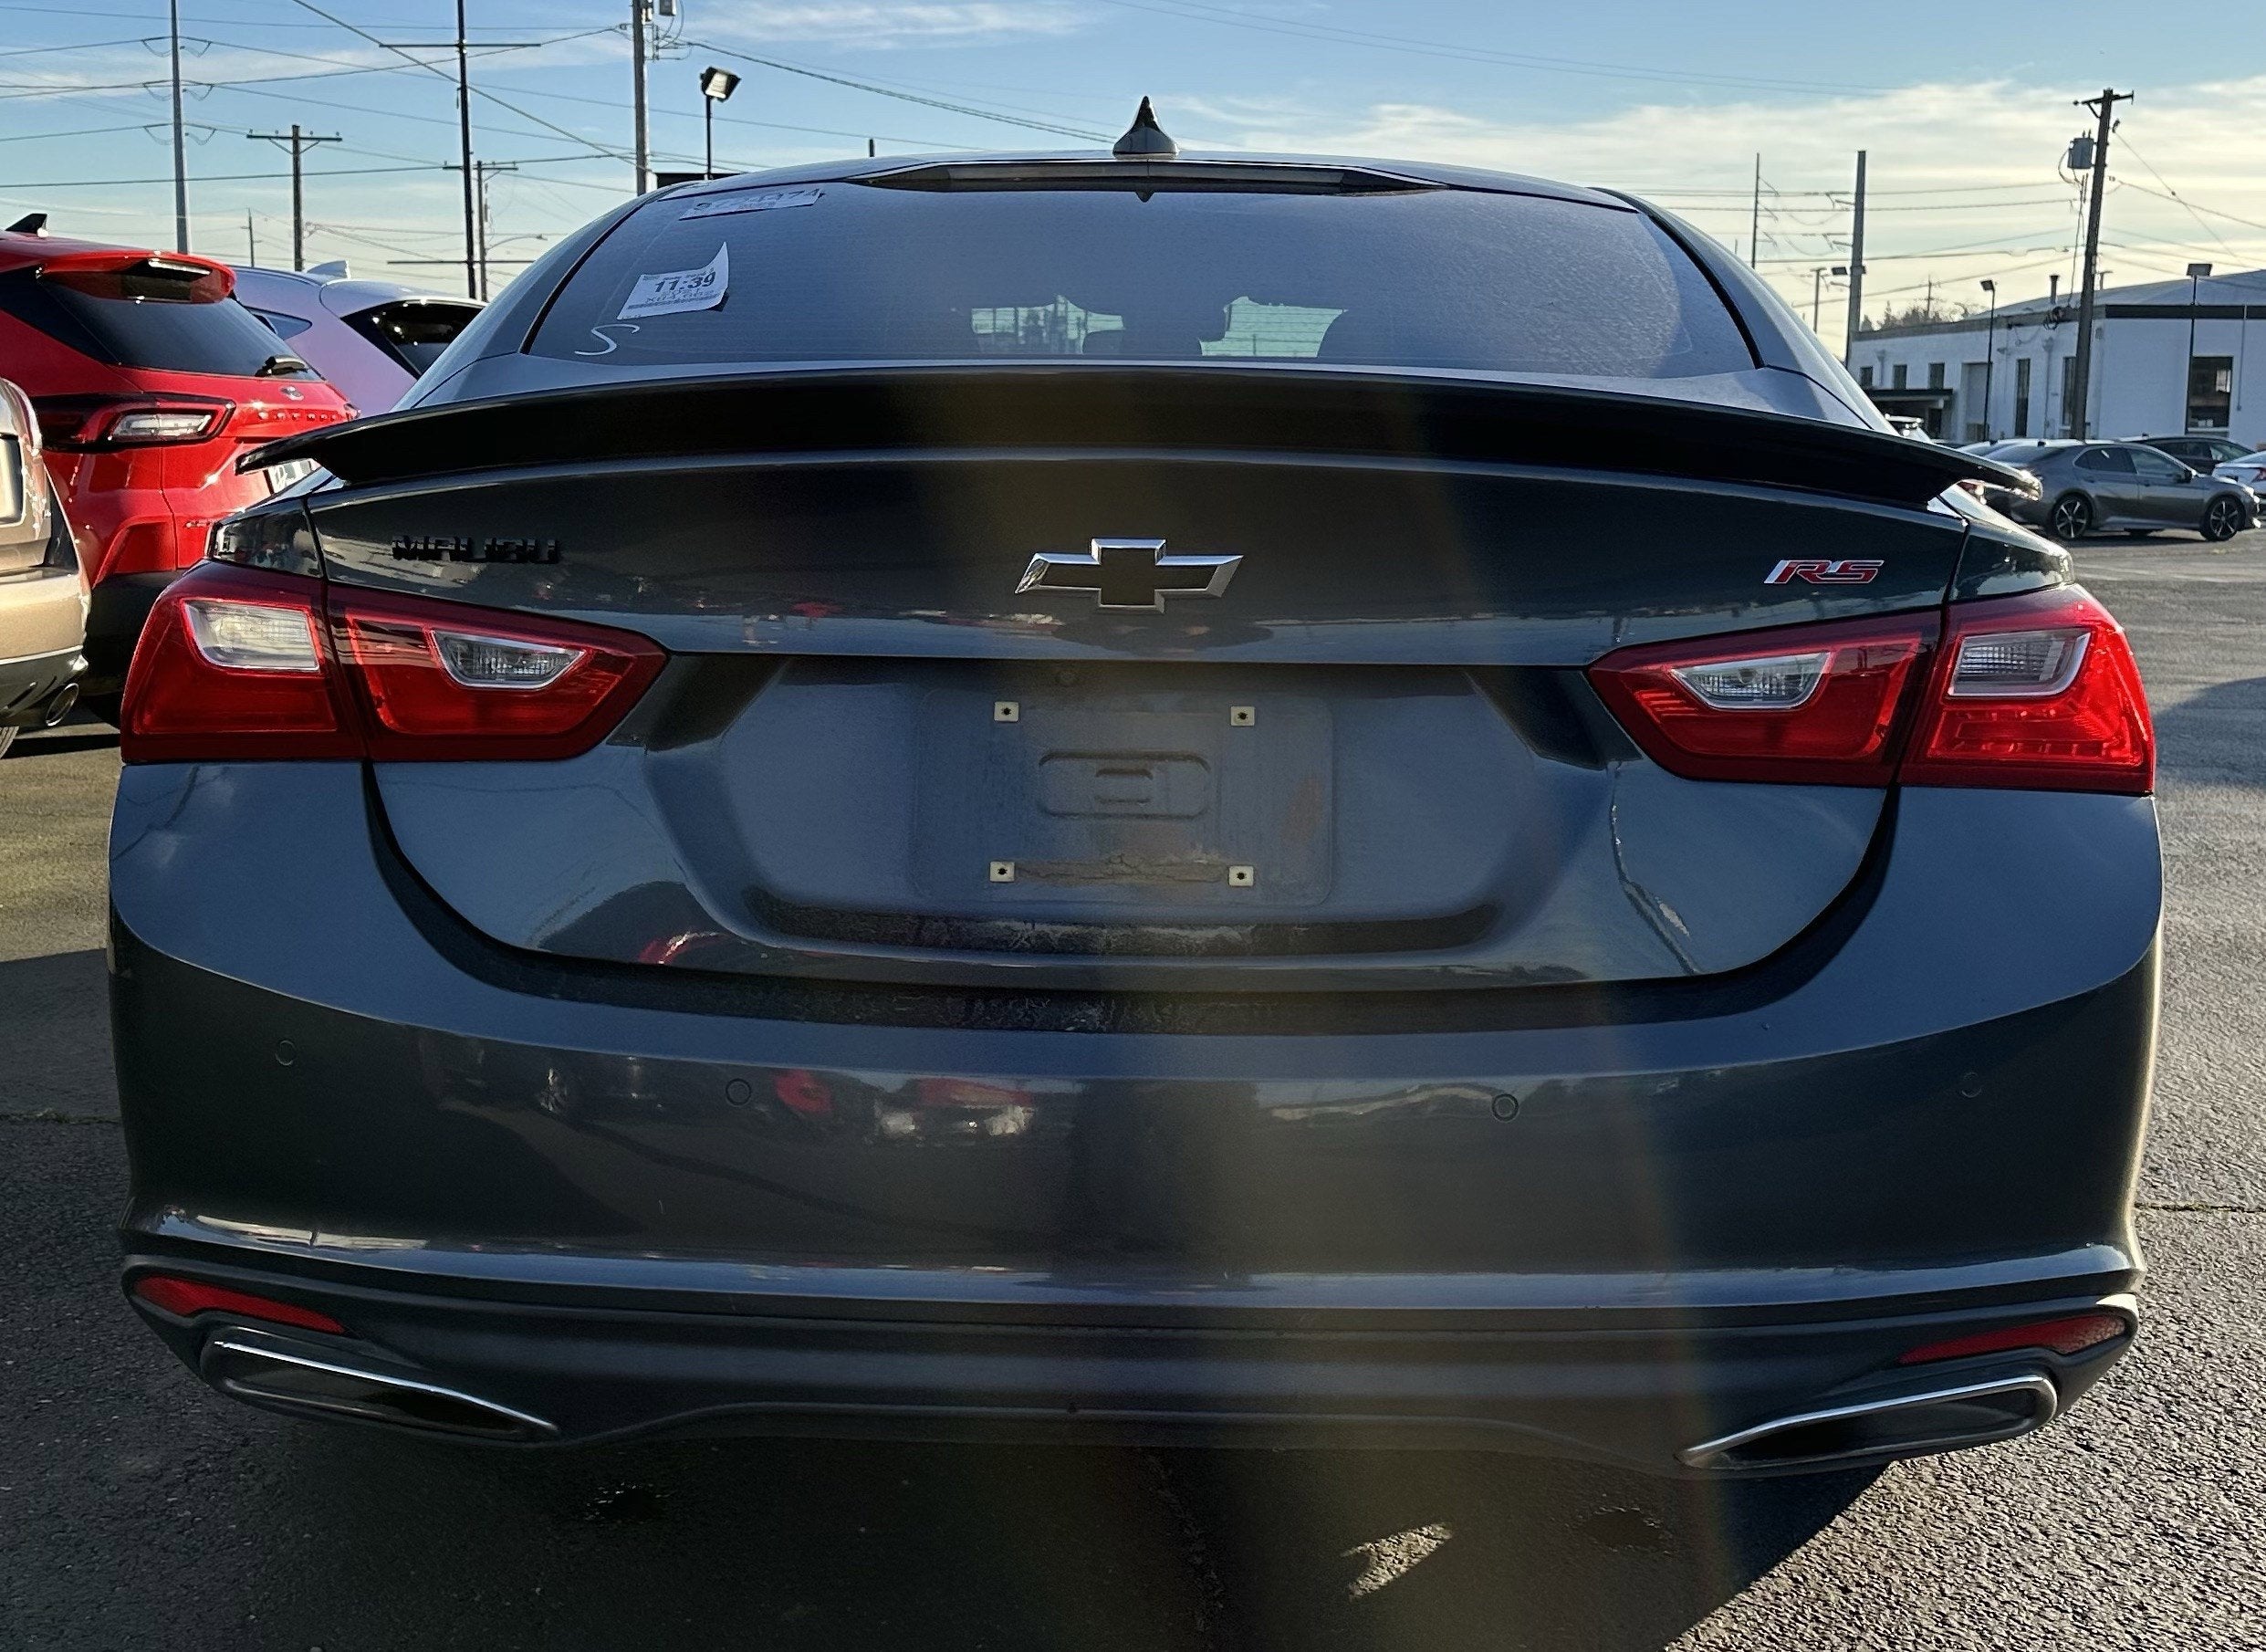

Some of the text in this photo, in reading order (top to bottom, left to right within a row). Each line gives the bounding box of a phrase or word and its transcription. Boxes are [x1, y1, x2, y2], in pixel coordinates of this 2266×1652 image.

[655, 271, 716, 293] 11:39
[392, 536, 559, 564] MALIBU
[1763, 559, 1885, 584] RS
